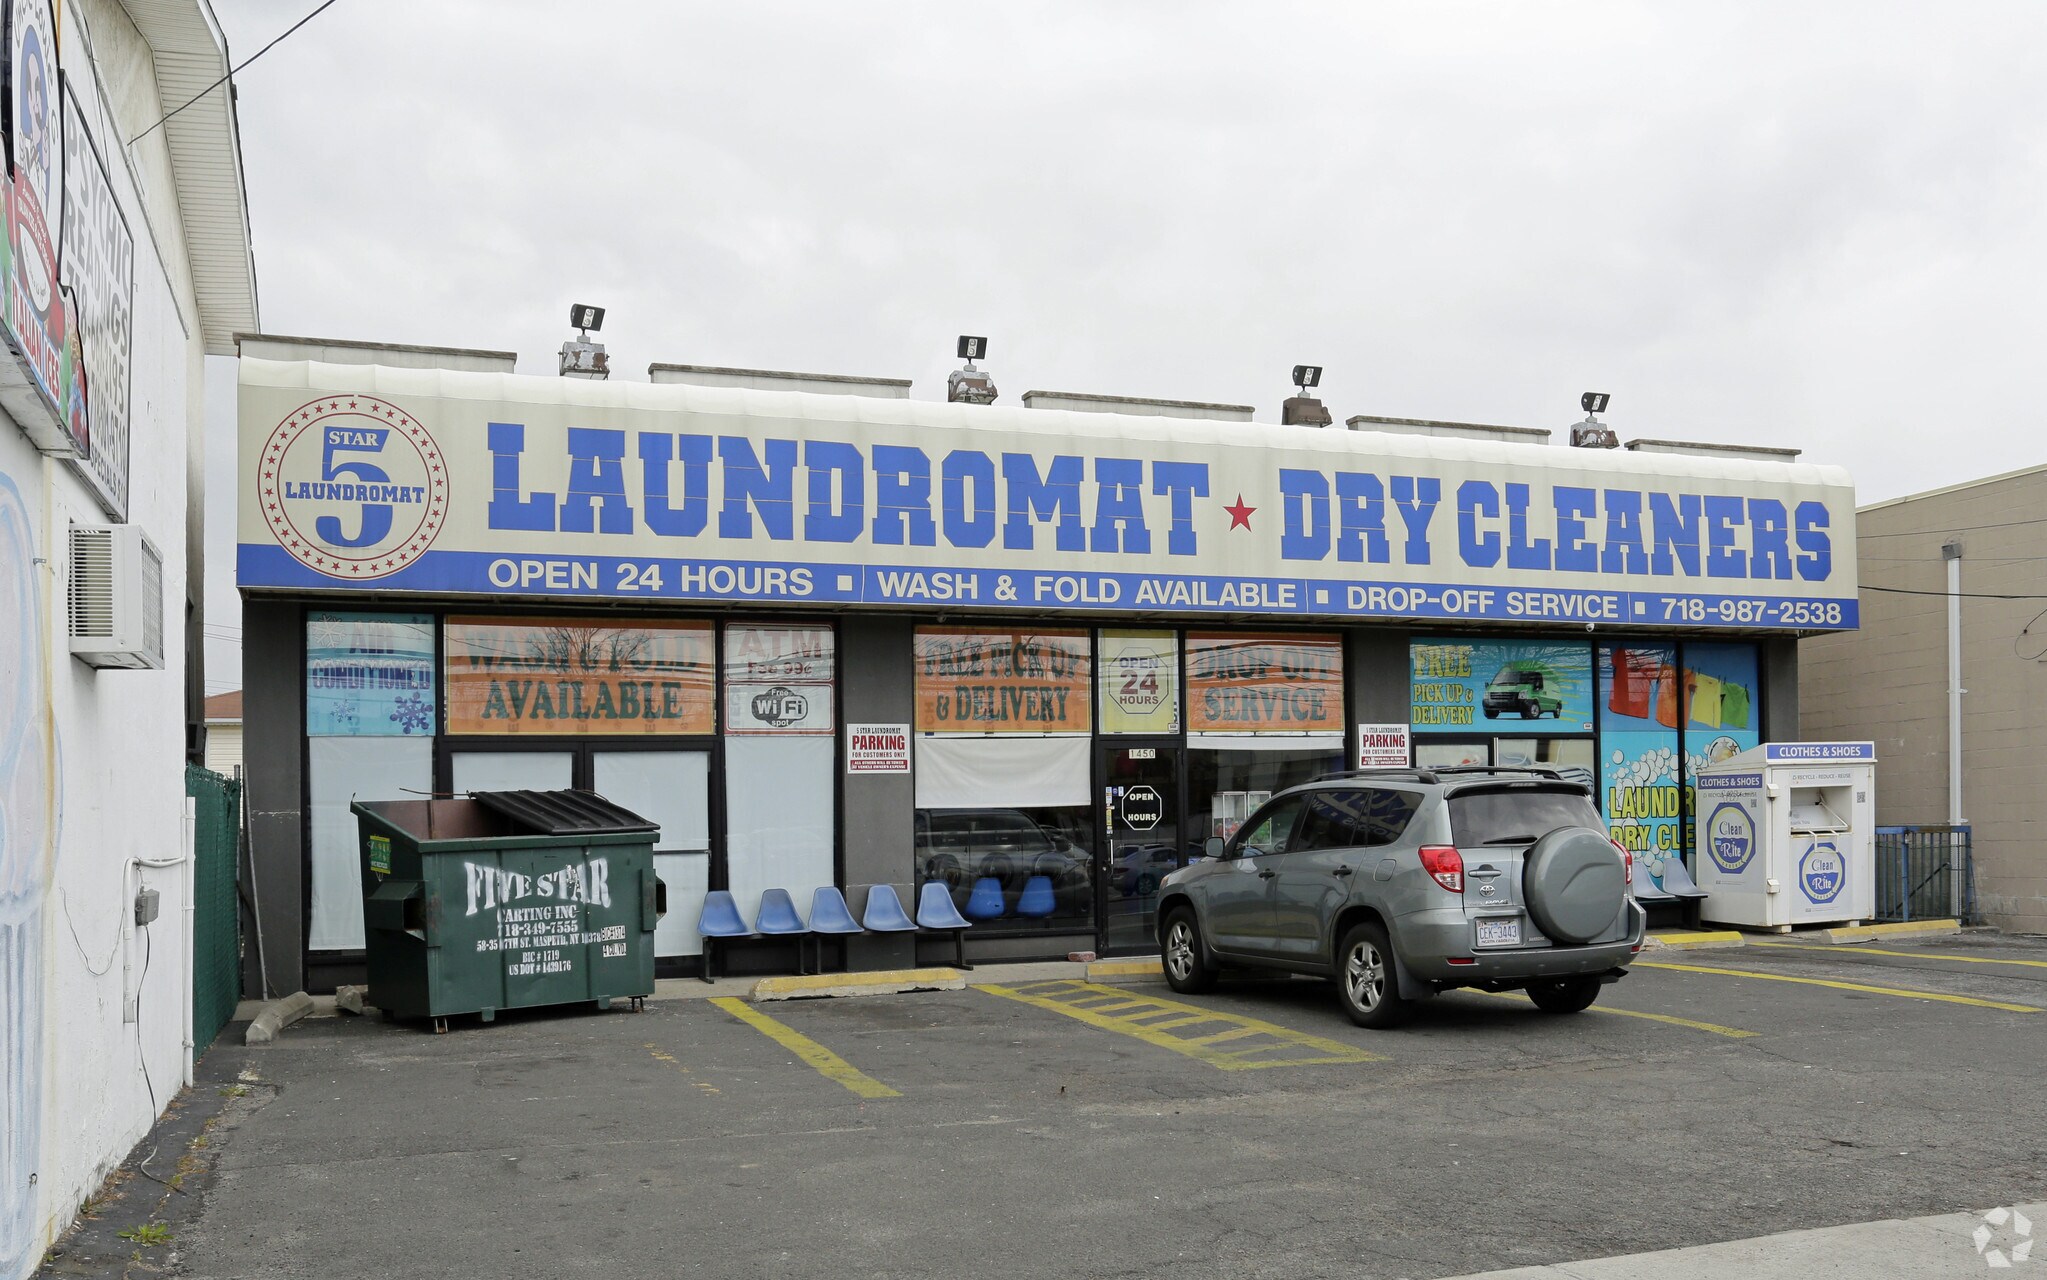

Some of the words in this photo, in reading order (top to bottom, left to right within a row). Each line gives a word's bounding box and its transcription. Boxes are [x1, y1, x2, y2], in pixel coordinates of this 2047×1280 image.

[66, 100, 129, 302] PSYCHIC
[65, 185, 127, 356] READINGS
[12, 278, 43, 377] ITALIAN
[44, 336, 60, 402] ICES
[329, 430, 378, 446] STAR
[285, 481, 425, 504] LAUNDROMAT
[315, 425, 392, 548] 5
[487, 422, 1210, 556] LAUNDROMAT
[1279, 468, 1441, 566] DRY
[1456, 479, 1832, 582] CLEANERS
[488, 558, 598, 590] OPEN
[616, 563, 664, 592] 24
[681, 565, 813, 597] HOURS
[877, 571, 979, 600] WASH
[994, 574, 1017, 601] &
[1034, 576, 1121, 604] FOLD
[1134, 579, 1297, 608] AVAILABLE
[1346, 586, 1495, 614] DROP-OFF
[1506, 593, 1619, 618] SERVICE
[1661, 598, 1842, 625] 718-987-2538
[349, 620, 395, 654] AIR
[738, 629, 822, 658] ATM
[464, 630, 572, 671] WASH
[608, 636, 698, 673] FOLD
[924, 639, 985, 677] FREE
[990, 642, 1043, 678] PICK
[1051, 643, 1081, 678] UP
[1414, 644, 1472, 678] FREE
[748, 662, 777, 675] Fee
[783, 661, 812, 675] 99¢
[1119, 656, 1159, 669] OPEN
[1194, 645, 1273, 679] DROP
[1280, 647, 1335, 680] OFF
[311, 658, 431, 690] CONDITIONED
[1119, 670, 1159, 695] 24
[481, 679, 683, 720] AVAILABLE
[771, 688, 789, 696] Free
[1119, 695, 1159, 705] HOURS
[1413, 684, 1444, 703] PICK
[1446, 684, 1463, 703] UP
[1465, 689, 1474, 703] &
[936, 695, 949, 721] &
[955, 685, 1070, 721] DELIVERY
[1204, 686, 1327, 722] SERVICE
[771, 719, 789, 727] spot
[1412, 706, 1475, 725] DELIVERY
[852, 735, 905, 750] PARKING
[1363, 734, 1405, 748] PARKING
[1131, 750, 1155, 758] 1450
[1779, 747, 1822, 757] CLOTHES
[1823, 747, 1830, 757] &
[1831, 746, 1861, 756] SHOES
[1701, 778, 1729, 787] CLOTHES
[1737, 777, 1760, 786] SHOES
[1129, 793, 1154, 801] OPEN
[1128, 813, 1156, 821] HOURS
[1719, 820, 1743, 836] Clean
[1610, 825, 1651, 851] DRY
[1720, 840, 1741, 858] Rite
[1811, 859, 1834, 872] Clean
[464, 862, 532, 916] FIVE
[537, 857, 611, 908] STAR
[1812, 875, 1832, 890] Rite
[497, 906, 551, 923] CARTING
[555, 905, 577, 919] INC
[497, 920, 578, 937] 718-349-7555
[1480, 925, 1517, 940] CEK-3443
[476, 939, 498, 952] 58-35
[520, 936, 531, 948] ST.
[570, 933, 579, 945] NY
[522, 951, 536, 963] BIC
[536, 953, 541, 961] #
[543, 950, 560, 961] 1719
[509, 964, 519, 975] US
[520, 963, 534, 975] DOT
[535, 964, 541, 973] #
[542, 960, 571, 973] 1439176
